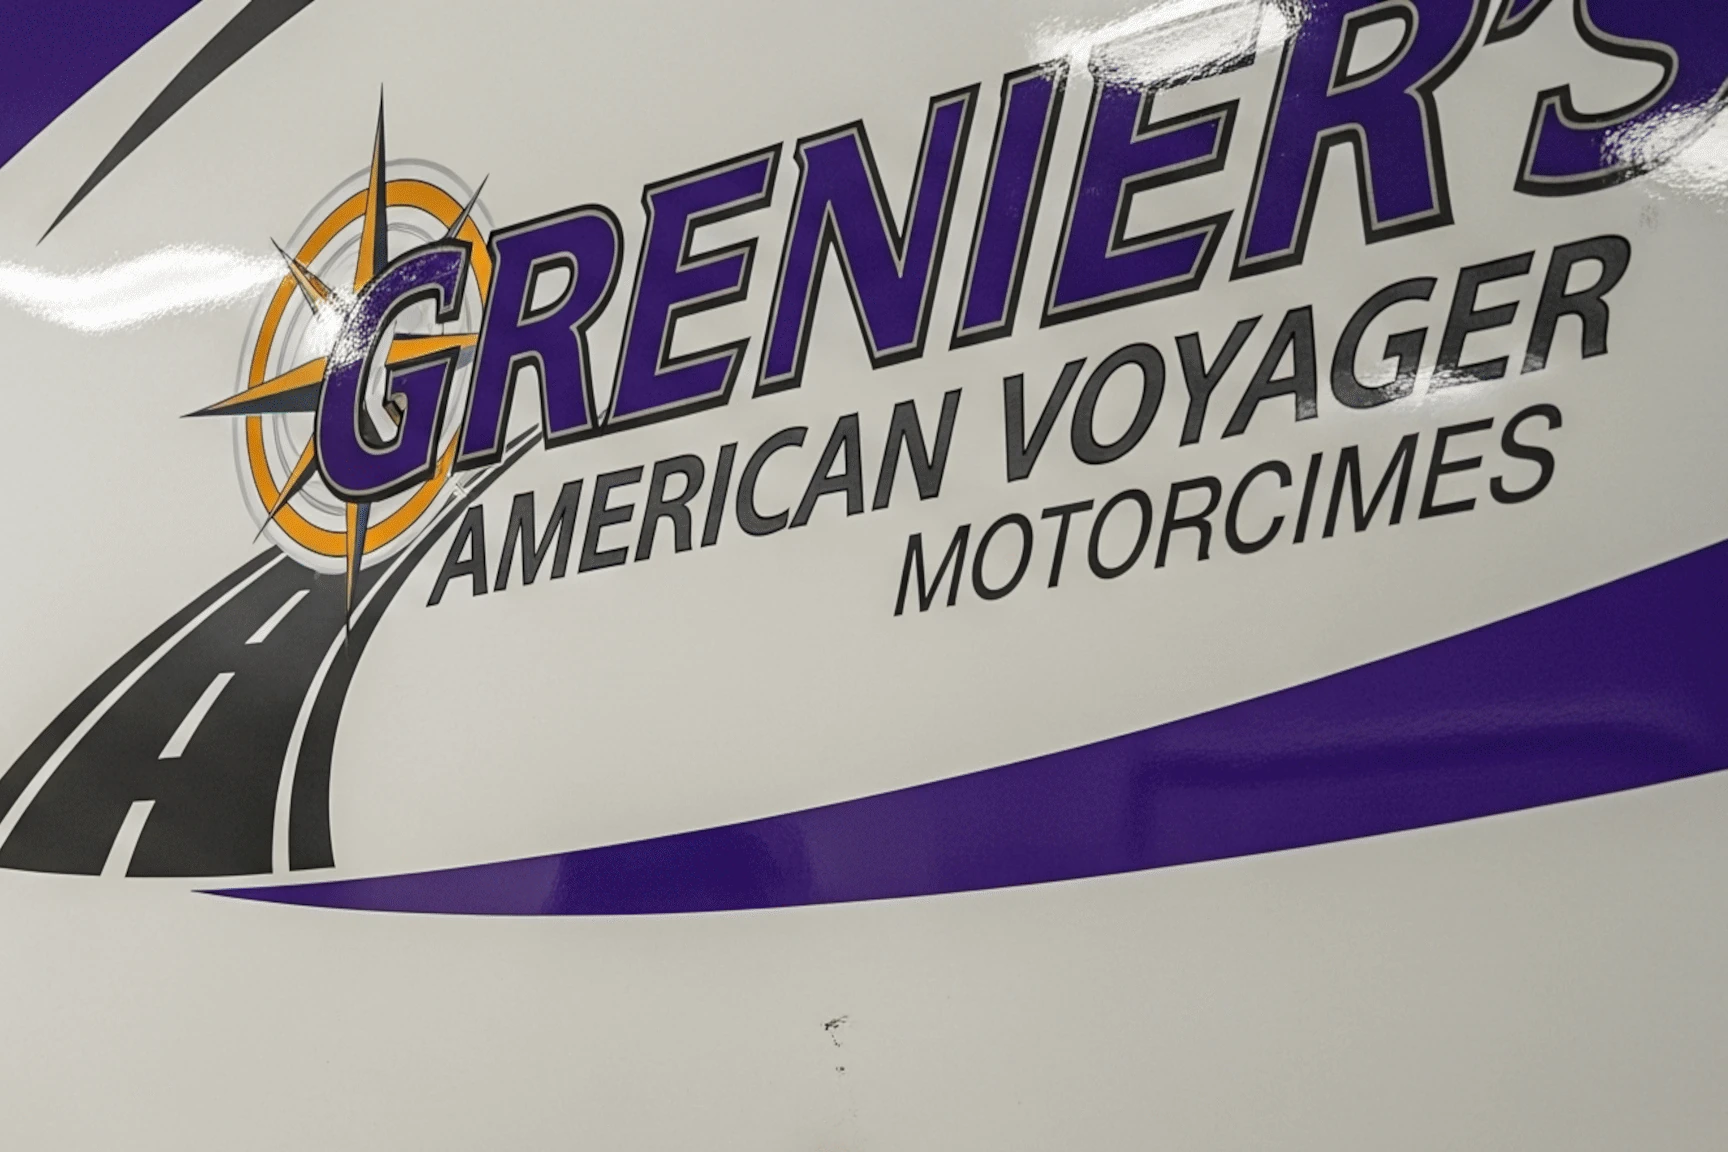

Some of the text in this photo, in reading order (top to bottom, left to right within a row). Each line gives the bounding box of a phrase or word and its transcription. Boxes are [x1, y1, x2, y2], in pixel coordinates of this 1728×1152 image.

[426, 234, 1633, 608] AMERICAN VOYAGER
[894, 403, 1563, 617] MOTORCIMES
